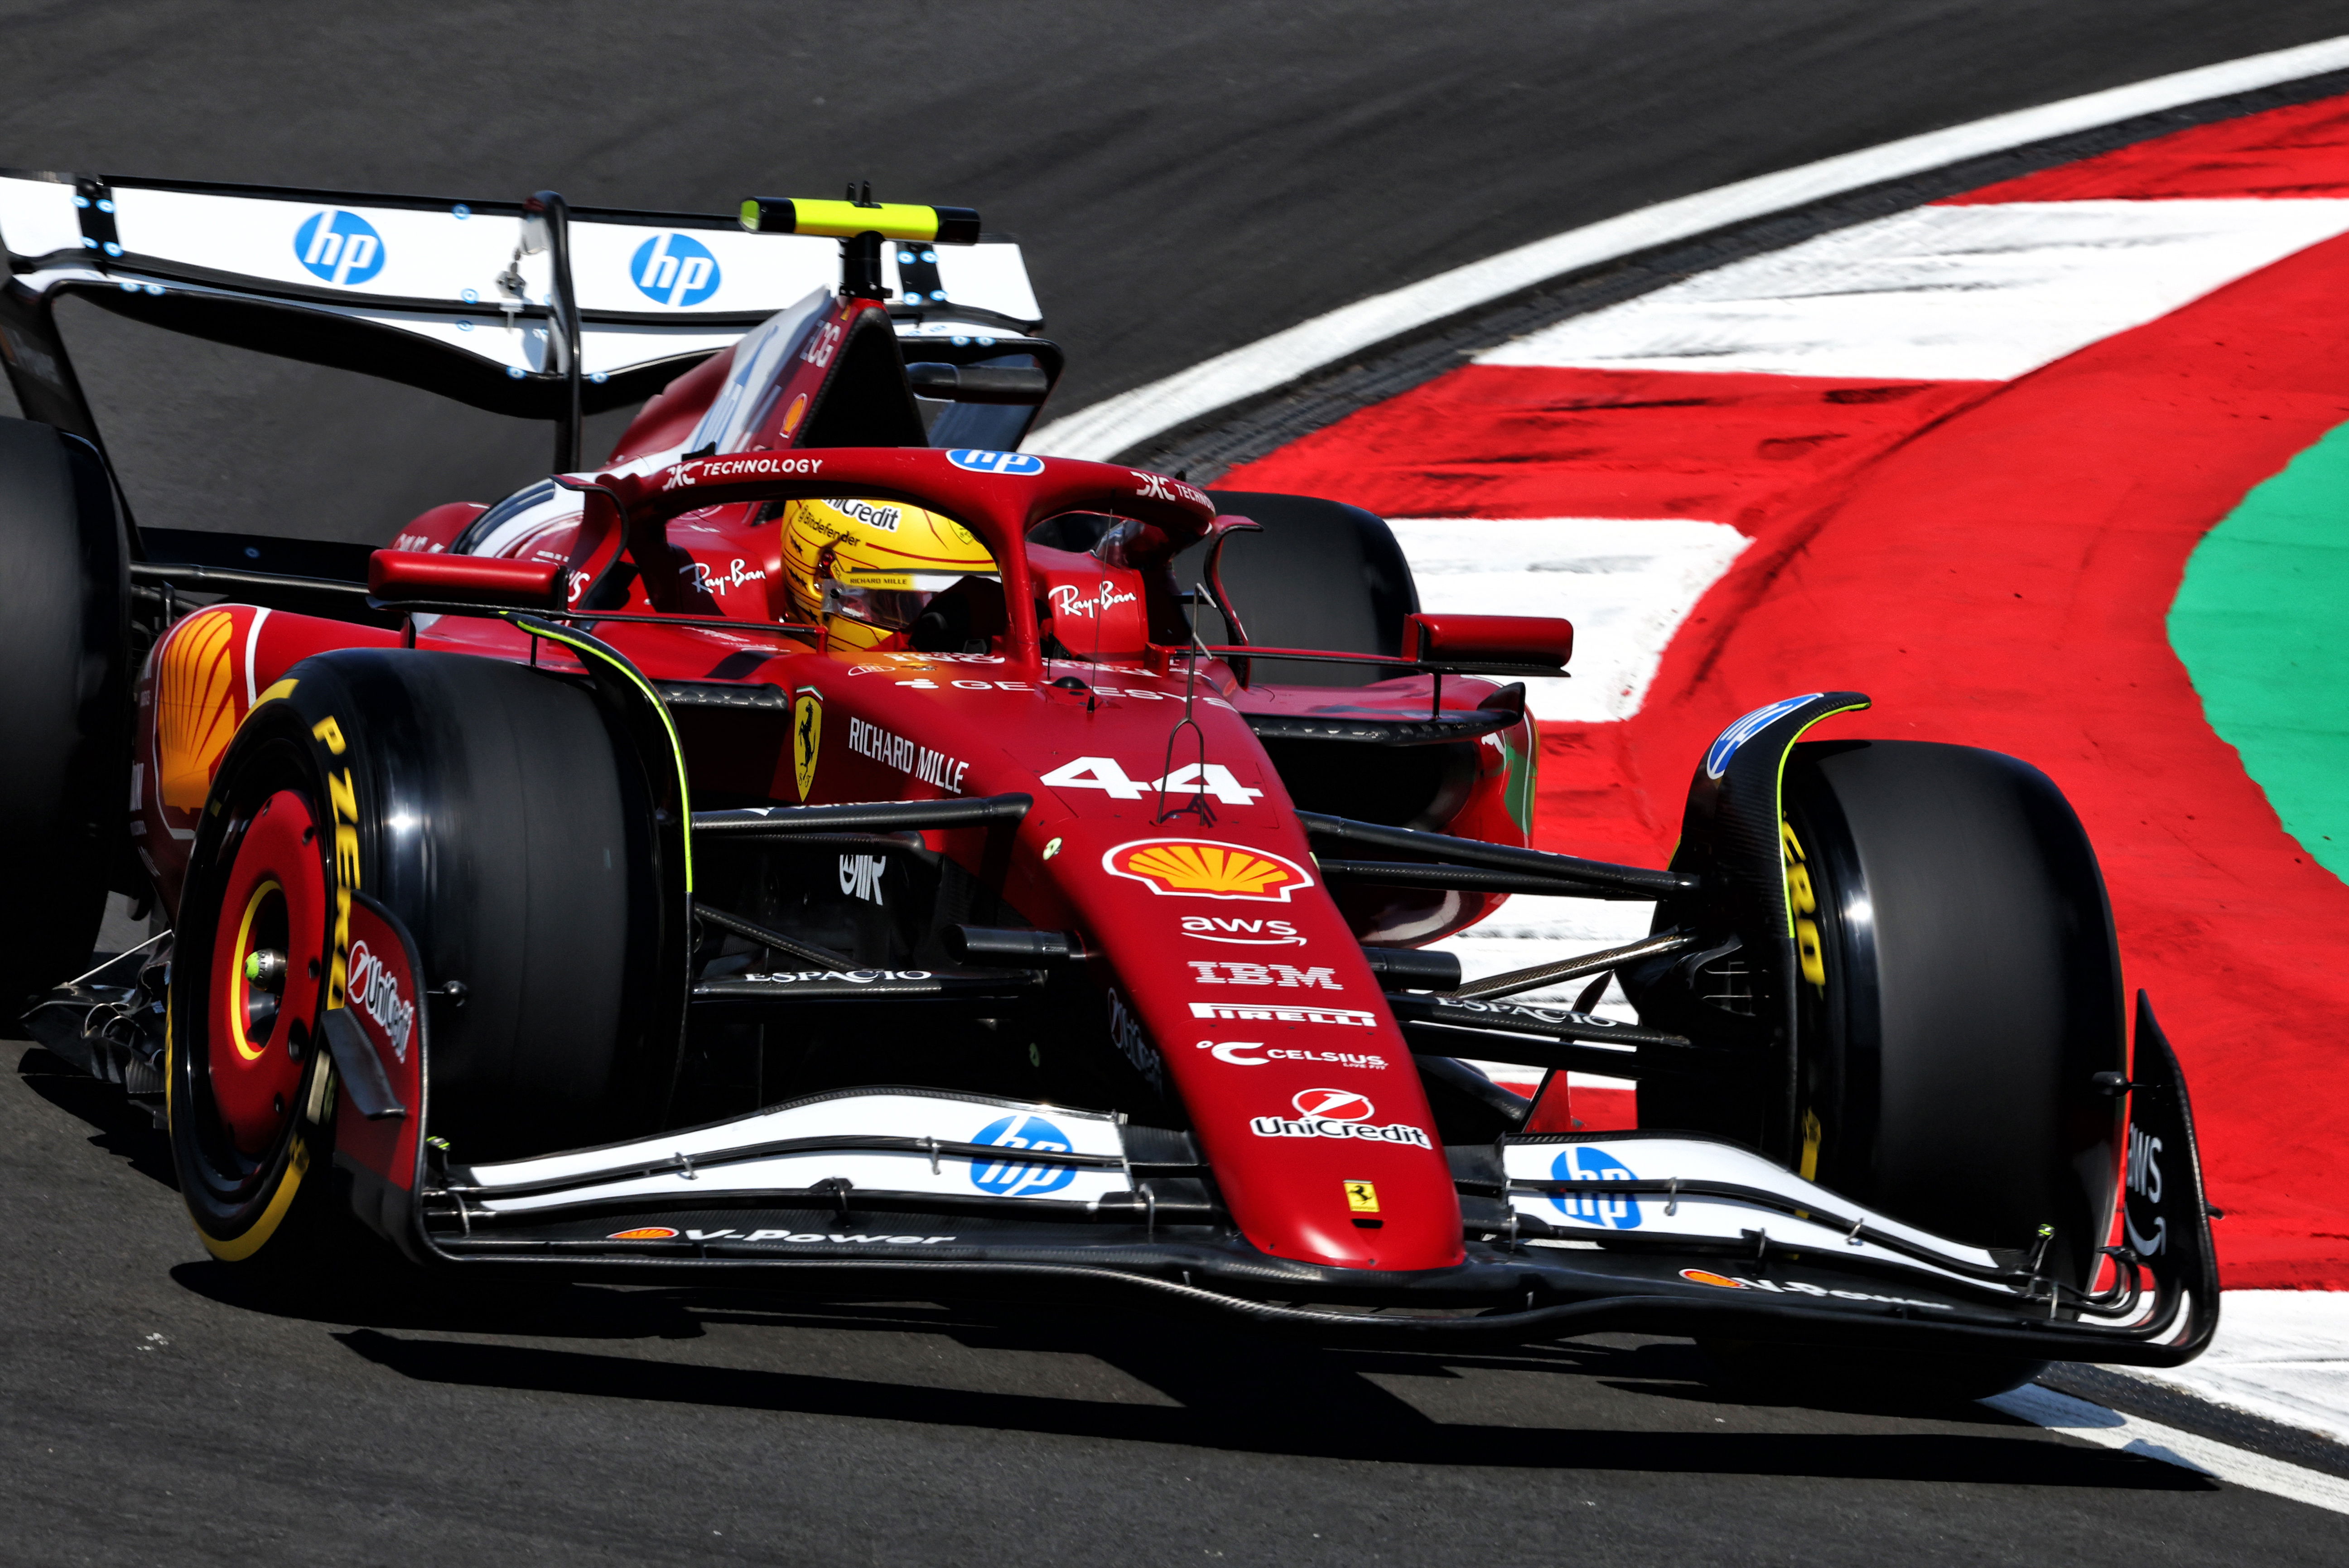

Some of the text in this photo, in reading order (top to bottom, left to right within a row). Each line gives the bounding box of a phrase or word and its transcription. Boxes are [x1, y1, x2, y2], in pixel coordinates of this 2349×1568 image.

[304, 210, 378, 285] hp
[640, 233, 714, 306] hp
[703, 459, 823, 476] TECHNOLOGY
[964, 449, 1029, 473] hp
[679, 559, 767, 596] Ray-Ban
[1048, 580, 1138, 618] Ray-Ban
[849, 716, 970, 795] RICHARD MILLE
[1039, 756, 1264, 806] 44
[1181, 916, 1298, 936] aws
[1187, 961, 1344, 990] IBM
[1188, 1002, 1378, 1027] PIRELLI
[1252, 1118, 1431, 1148] UniCredit
[975, 1116, 1071, 1196] hp
[685, 1229, 957, 1245] V-Power
